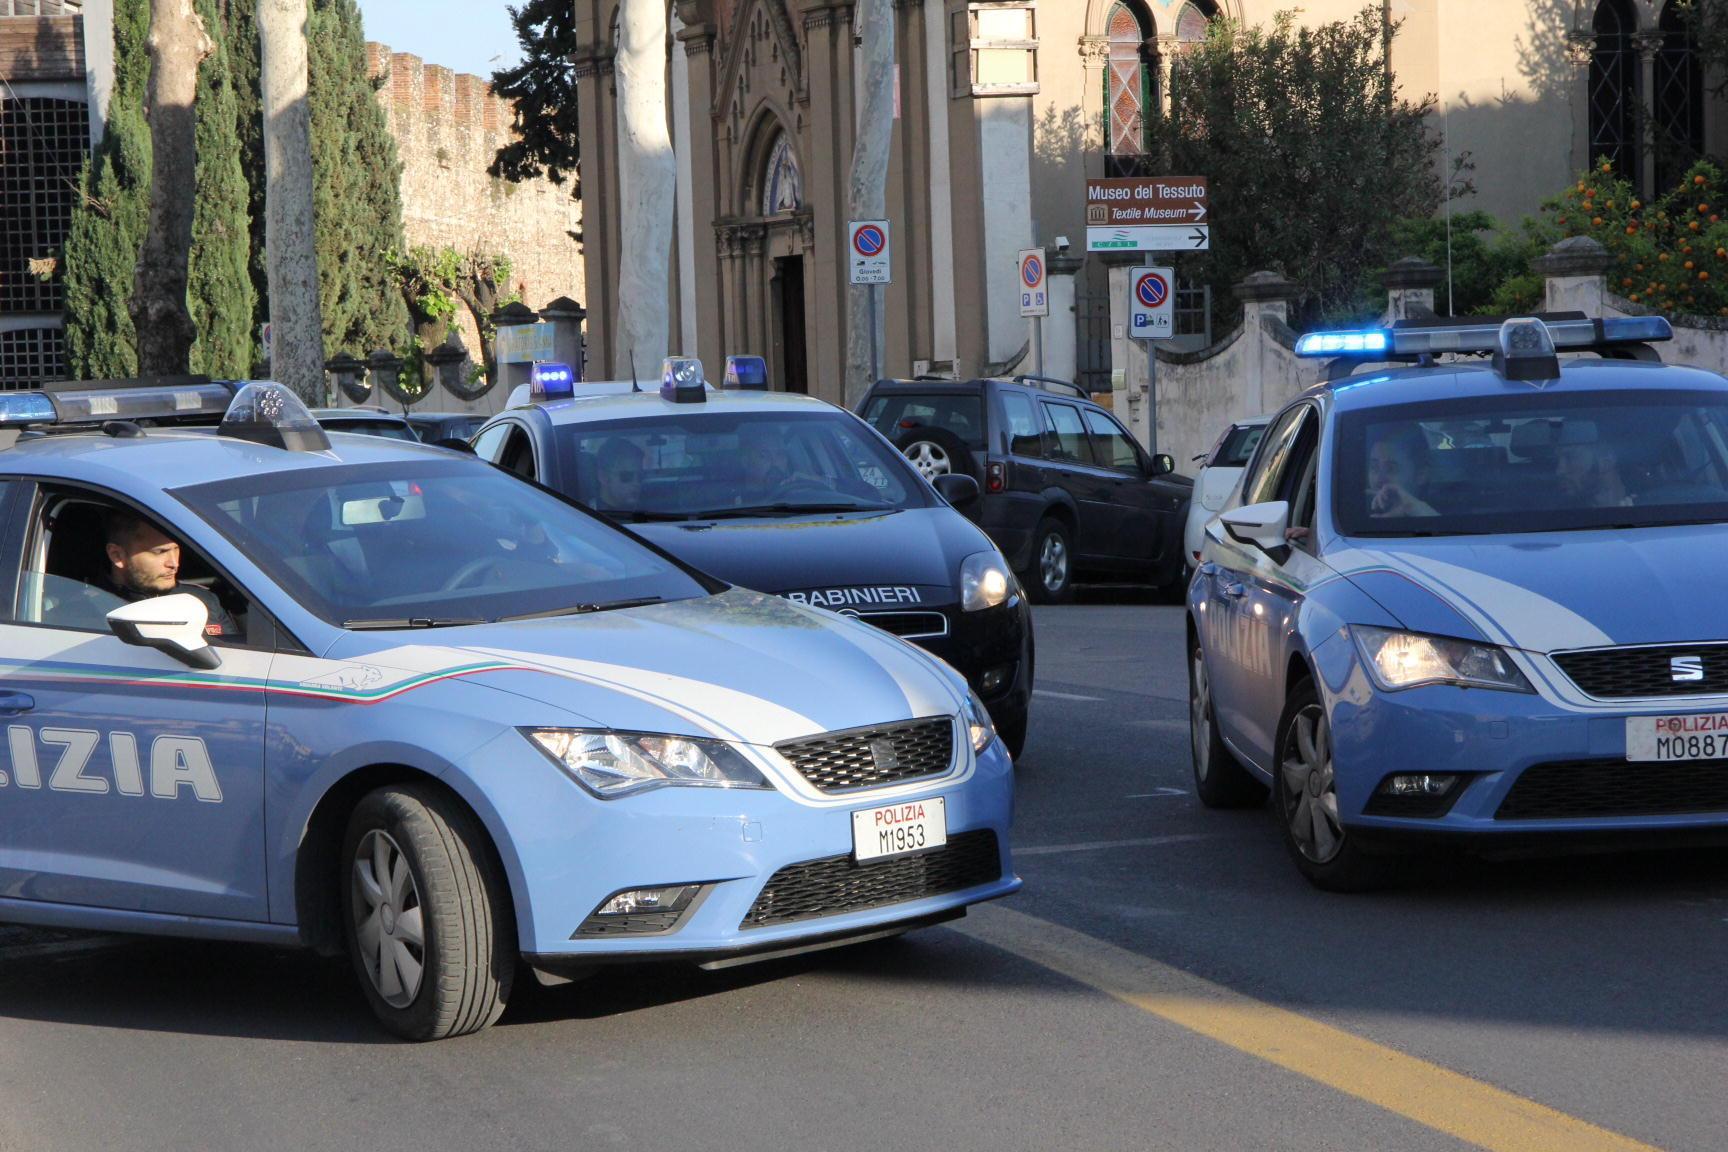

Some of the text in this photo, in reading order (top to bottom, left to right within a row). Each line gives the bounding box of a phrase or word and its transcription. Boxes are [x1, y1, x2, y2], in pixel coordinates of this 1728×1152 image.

[1088, 183, 1205, 200] Museo del Tessuto
[1112, 207, 1187, 219] Textile Museum
[1136, 315, 1145, 326] P
[775, 586, 921, 608] RABINIERI
[1655, 715, 1728, 733] POLIZIA
[0, 724, 224, 804] IZIA
[874, 804, 926, 826] POLIZIA
[879, 824, 925, 854] M1953
